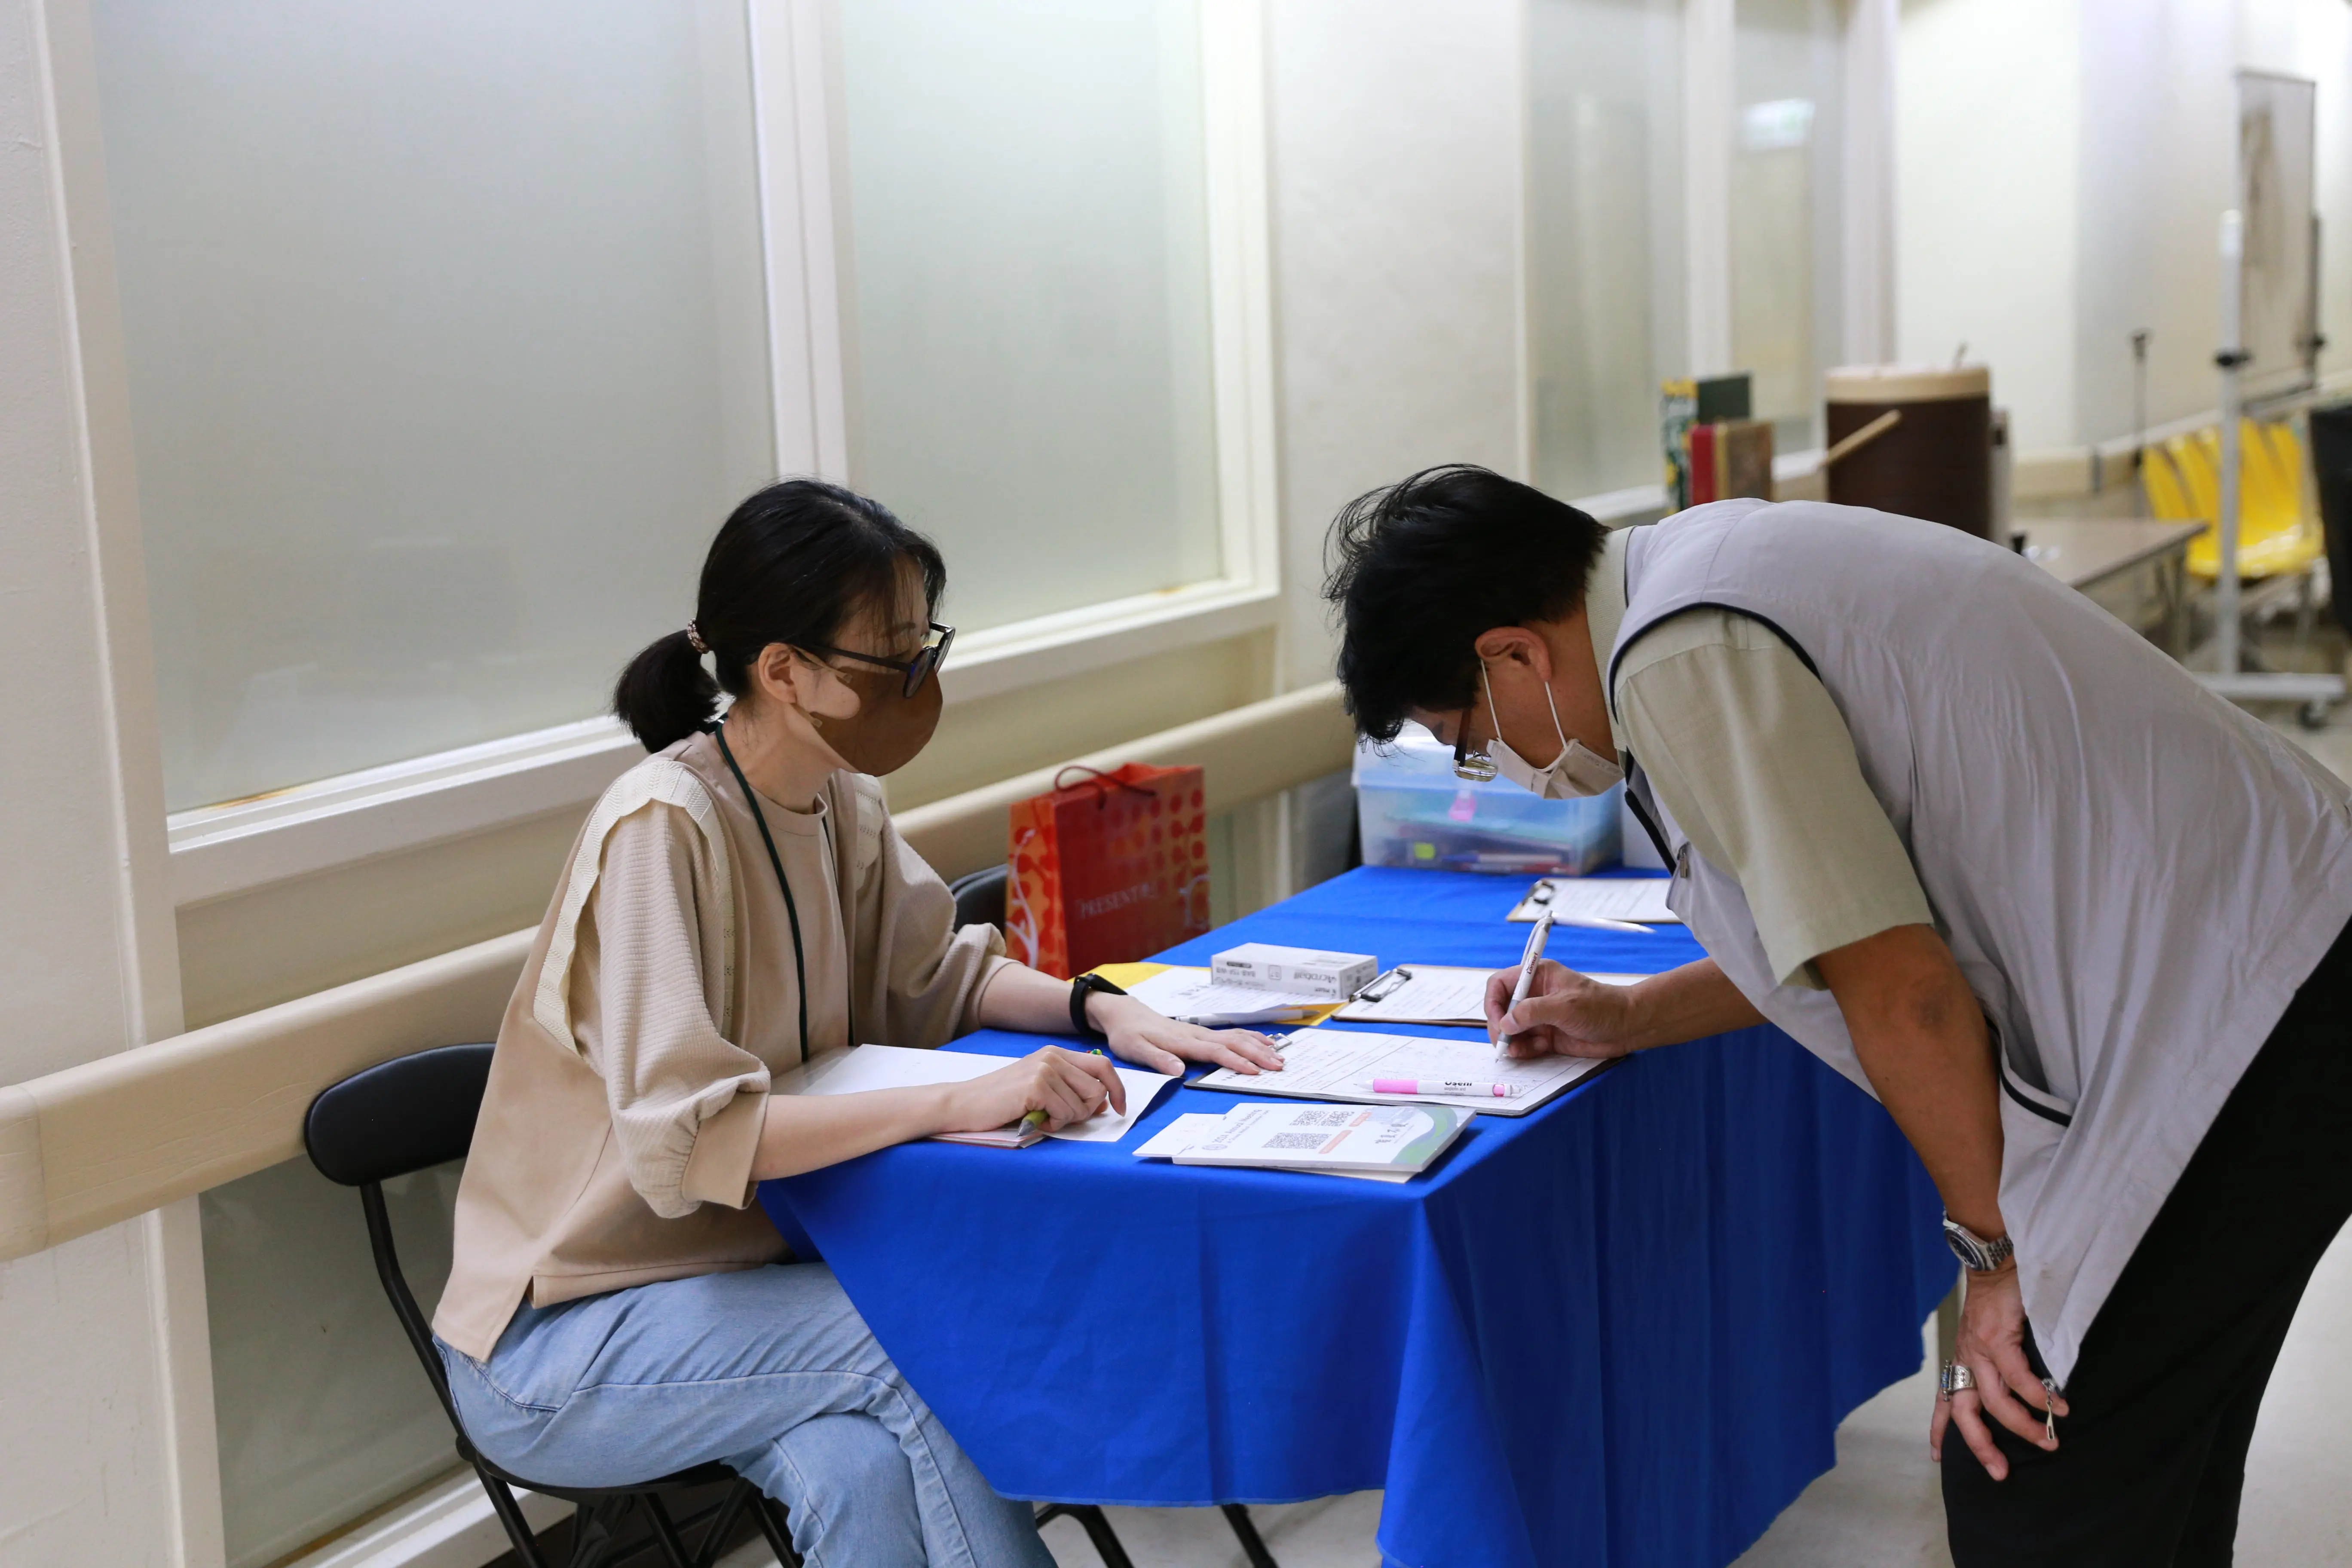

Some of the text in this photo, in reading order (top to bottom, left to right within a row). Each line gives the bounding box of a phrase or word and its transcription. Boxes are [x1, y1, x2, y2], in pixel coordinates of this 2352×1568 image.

[1527, 952, 1538, 974] Lonsurf
[1294, 971, 1336, 983] Acroball
[1225, 1123, 1244, 1133] Annual
[1239, 1109, 1262, 1121] Meeting
